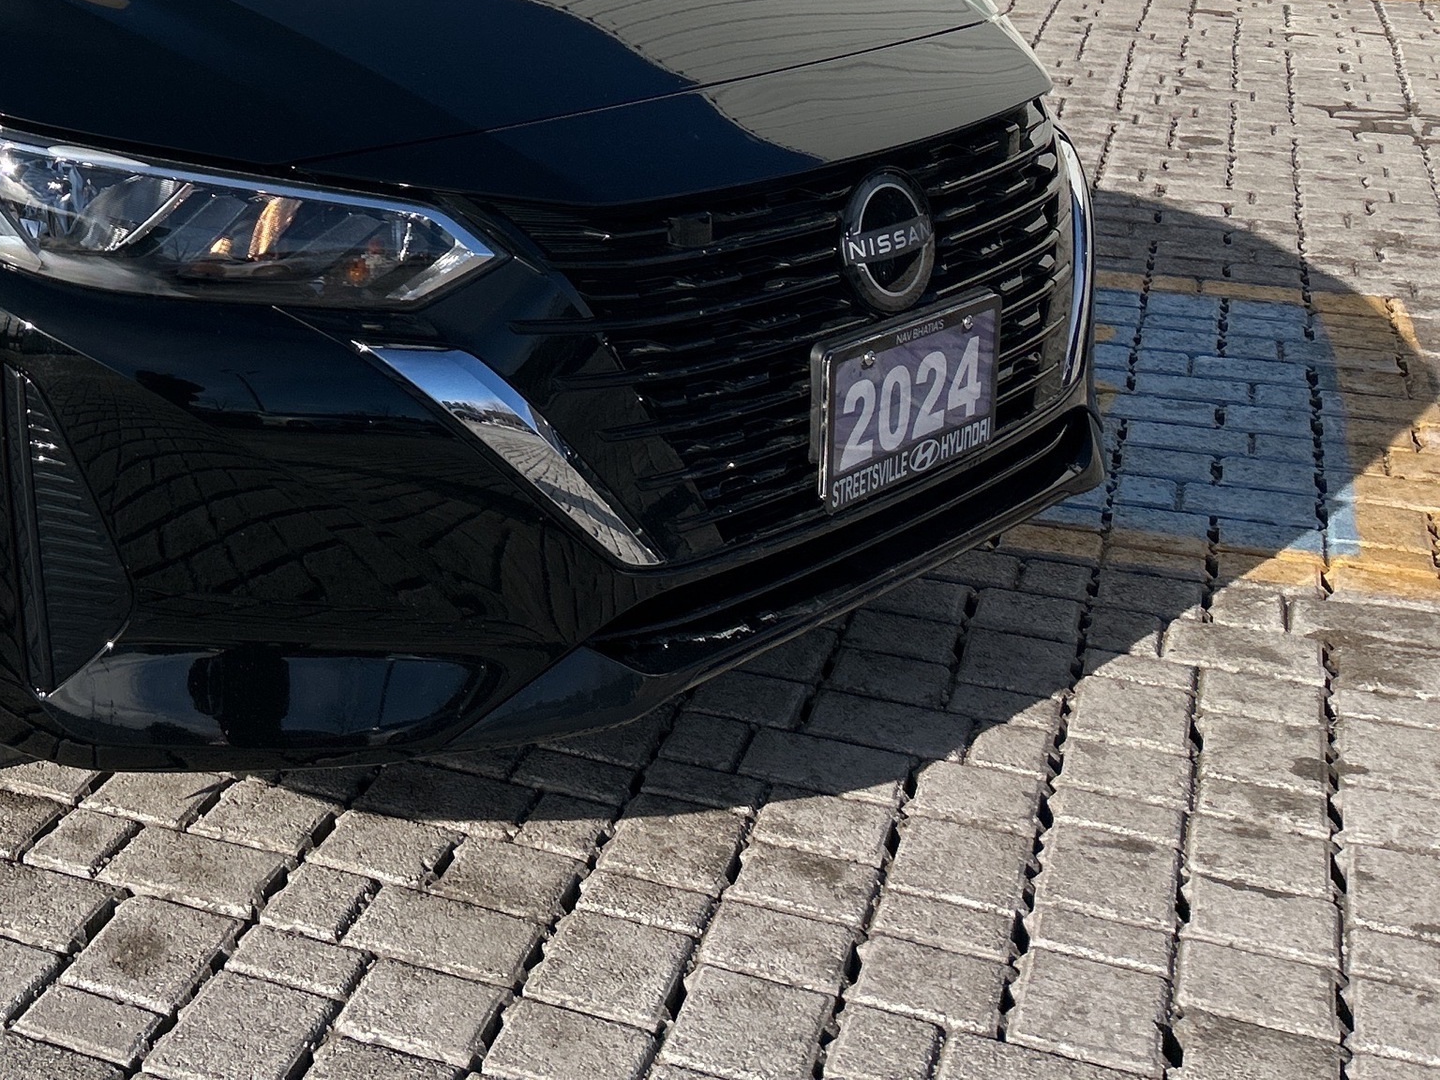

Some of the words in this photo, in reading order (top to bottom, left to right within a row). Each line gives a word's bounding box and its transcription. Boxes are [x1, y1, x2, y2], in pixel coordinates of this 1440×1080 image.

[848, 221, 931, 260] NISSAN
[895, 333, 911, 345] NAV
[912, 319, 944, 338] BHATIA'S
[839, 335, 982, 471] 2024
[832, 451, 909, 508] STREETSVILLE
[940, 416, 991, 460] HYUNDAI
